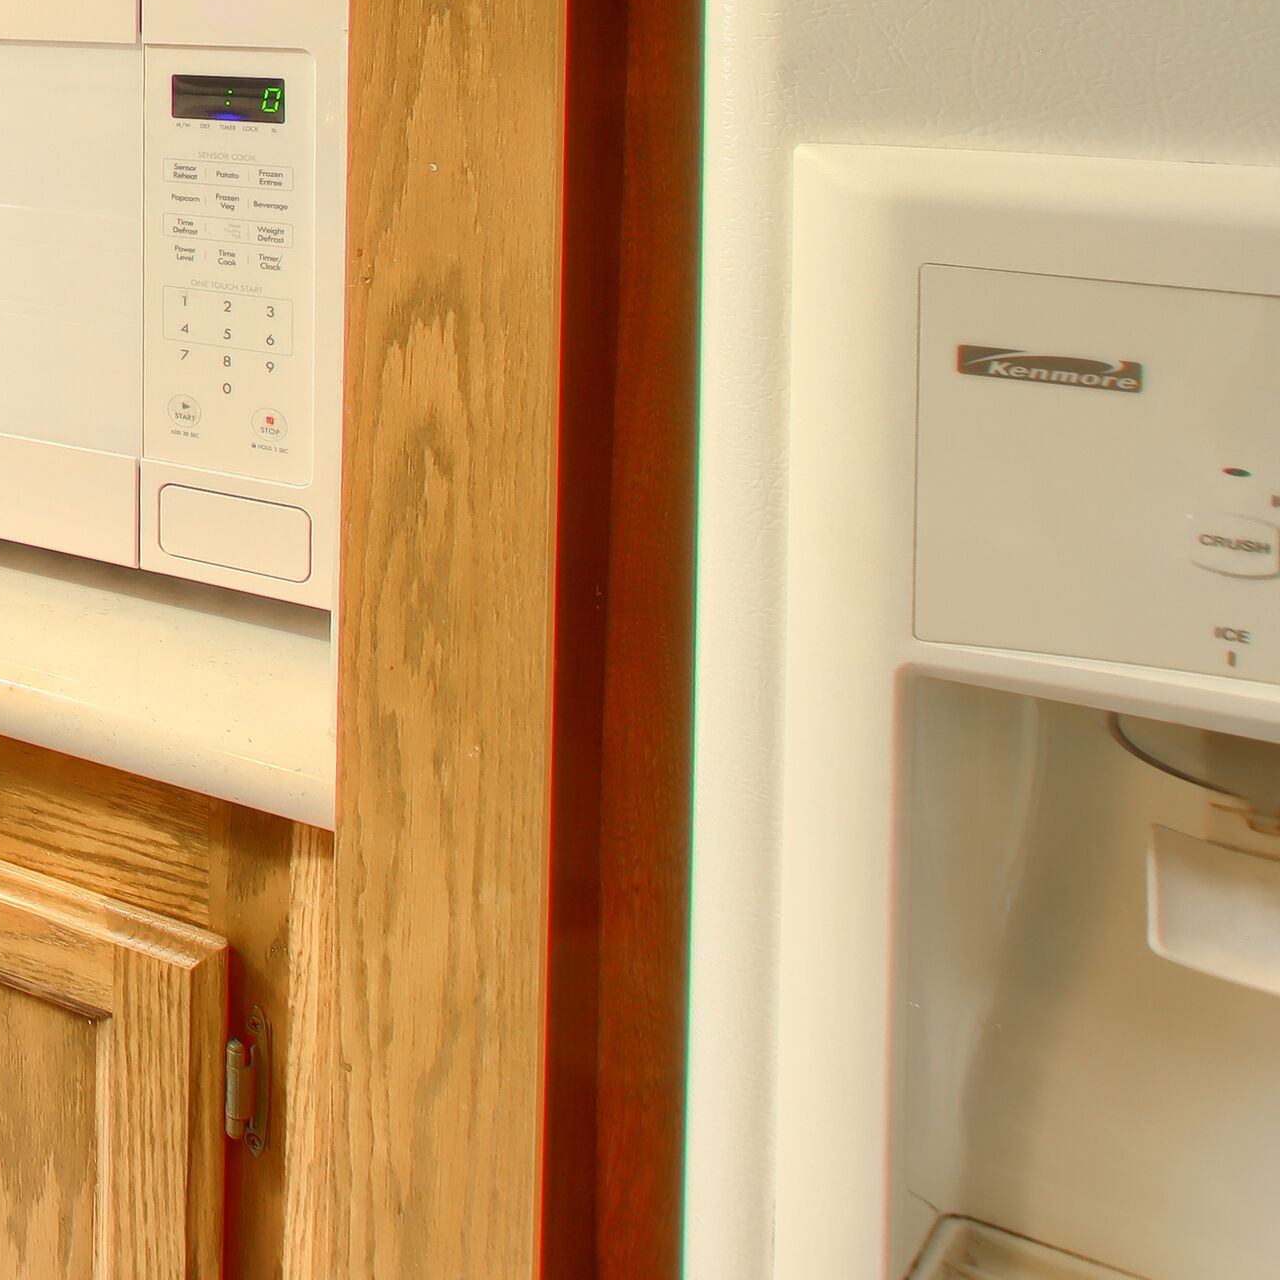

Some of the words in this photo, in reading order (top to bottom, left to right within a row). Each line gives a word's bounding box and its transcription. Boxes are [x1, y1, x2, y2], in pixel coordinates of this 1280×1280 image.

[197, 151, 229, 160] SENSOR
[231, 153, 256, 161] COOK
[174, 163, 197, 171] Sensor
[173, 172, 198, 180] Reheat
[216, 171, 239, 179] Potato
[258, 170, 283, 178] Frozen
[259, 178, 282, 187] Entree
[171, 193, 200, 203] Popcorn
[215, 193, 239, 201] Frozen
[220, 202, 235, 211] Veg
[253, 200, 288, 211] Beverage
[177, 218, 194, 226] Time
[172, 226, 198, 235] Defrost
[257, 226, 285, 235] Weight
[257, 235, 284, 244] Defrost
[174, 245, 196, 253] Power
[218, 249, 236, 257] Time
[176, 254, 194, 262] Level
[217, 258, 237, 266] Cook
[260, 262, 282, 271] Clock
[191, 279, 209, 288] ONE
[210, 281, 239, 291] TOUCH
[240, 285, 263, 293] START
[181, 295, 187, 307] 1
[223, 300, 232, 312] 2
[266, 306, 275, 318] 3
[180, 323, 189, 334] 4
[223, 328, 231, 340] 5
[266, 334, 275, 346] 6
[180, 349, 189, 360] 7
[223, 355, 231, 367] 8
[265, 361, 275, 373] 9
[988, 360, 1138, 390] Kenmore
[222, 382, 232, 394] 0
[174, 412, 196, 421] START
[260, 426, 280, 436] STOP
[257, 443, 272, 452] HOLD
[278, 446, 288, 454] SEC
[1198, 533, 1272, 554] CRUSH
[1213, 625, 1251, 644] ICE
